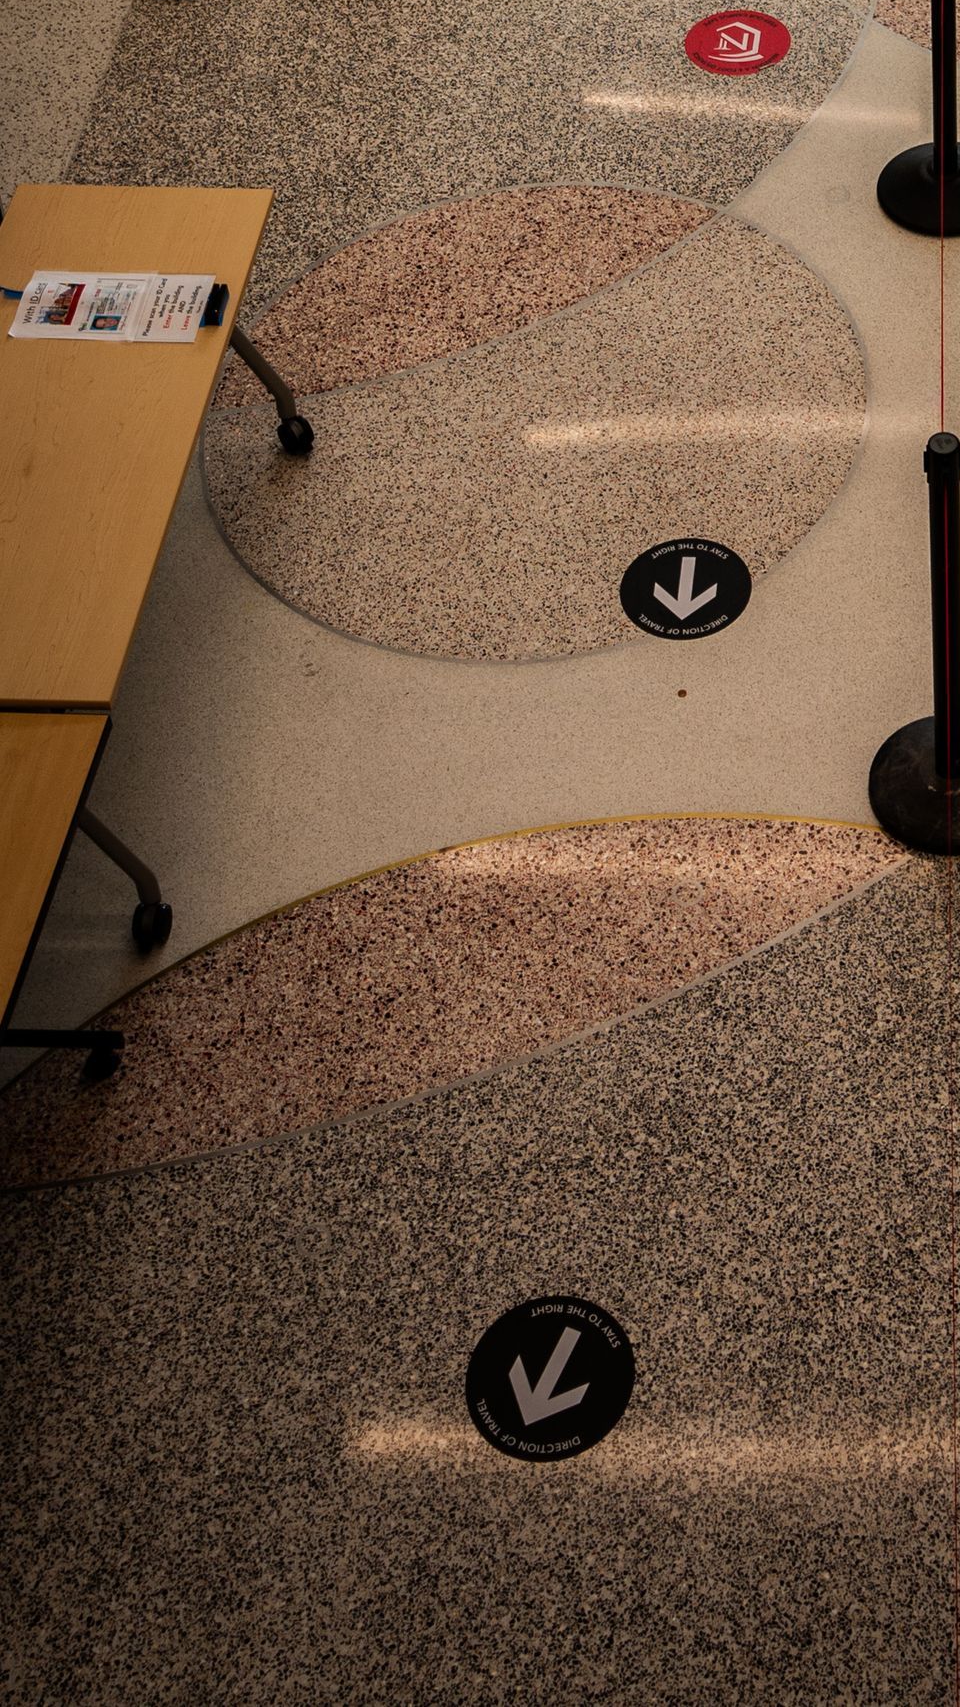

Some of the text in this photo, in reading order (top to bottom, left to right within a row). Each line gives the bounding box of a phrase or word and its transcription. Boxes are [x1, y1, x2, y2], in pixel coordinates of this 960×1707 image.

[23, 306, 36, 324] With
[30, 296, 38, 304] ID
[142, 320, 152, 336] Please
[159, 278, 168, 288] Card
[163, 315, 172, 328] Enter
[181, 316, 190, 330] Leave
[651, 545, 676, 559] RIGHT
[711, 547, 729, 560] STAY
[638, 614, 665, 632] TRAVEL
[682, 614, 728, 635] DIRECTION
[530, 1304, 622, 1348] STAY TO THE RIGHT
[477, 1398, 580, 1454] DIRECTION OF TRAVEL
